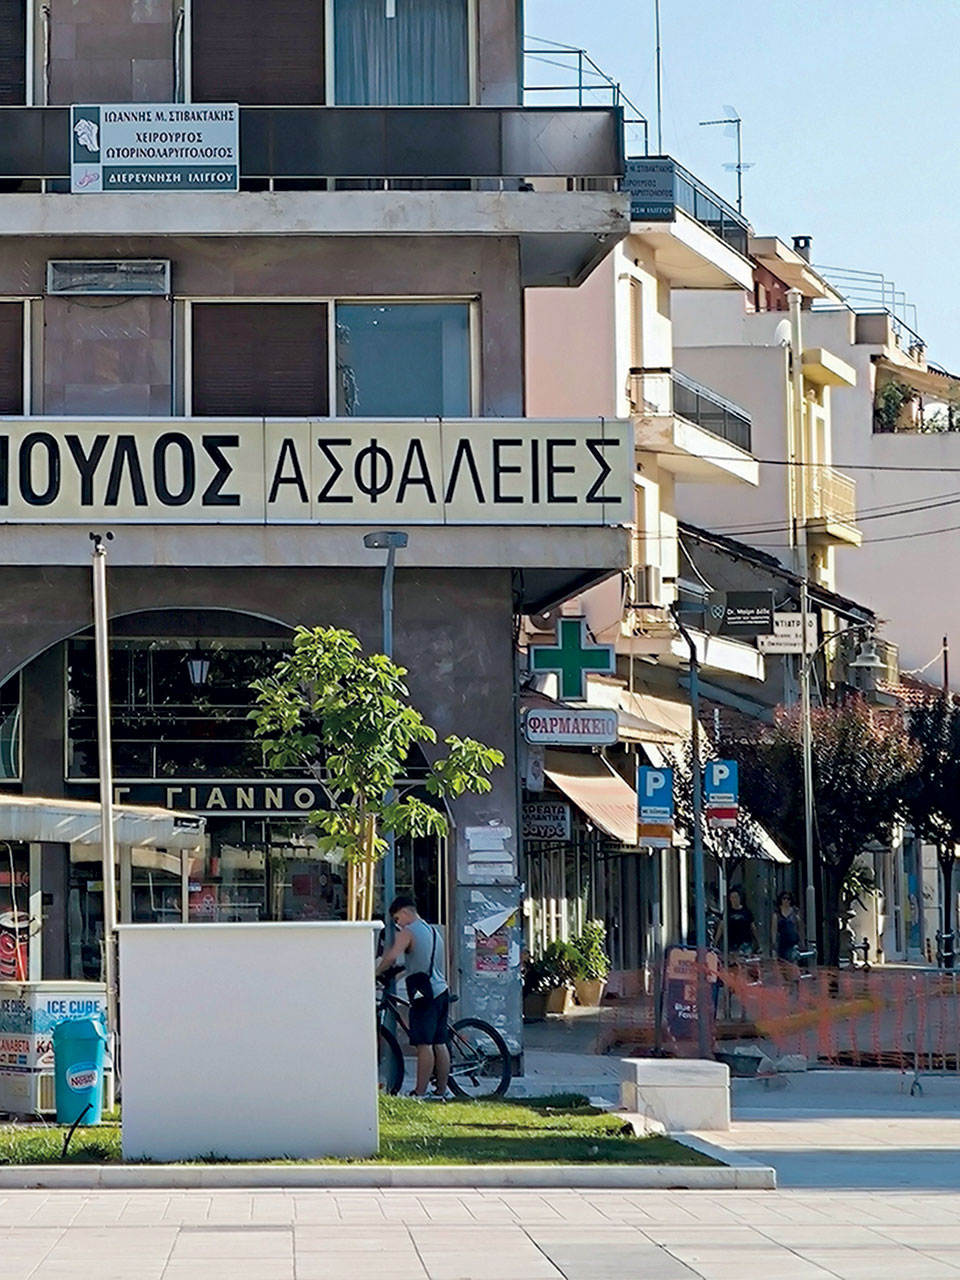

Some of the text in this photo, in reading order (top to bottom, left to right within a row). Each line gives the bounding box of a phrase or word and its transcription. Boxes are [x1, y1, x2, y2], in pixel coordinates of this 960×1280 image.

[105, 110, 152, 123] ΙΩΑΝΝΗΣ
[169, 110, 234, 122] ΣΤΙΒΑΚΤΑΚΗΣ
[136, 132, 203, 143] ΧΕΙΡΟΥΡΓΟΣ
[106, 147, 233, 159] ΩΤΟΡΙΝΟΛΑΡΥΓΓΟΛΟΓΟΣ
[108, 172, 233, 184] ΔΙΕΡΕΥΝΗΣΗ ΙΛΙΓΓΟΥ
[268, 437, 623, 505] ΑΣΦΑΛΕΙΕΣ
[528, 717, 616, 736] ΦΑΡΜΑΚΕΙΟ
[712, 764, 730, 787] P
[646, 771, 666, 797] P
[47, 1001, 101, 1014] ICE CUBE
